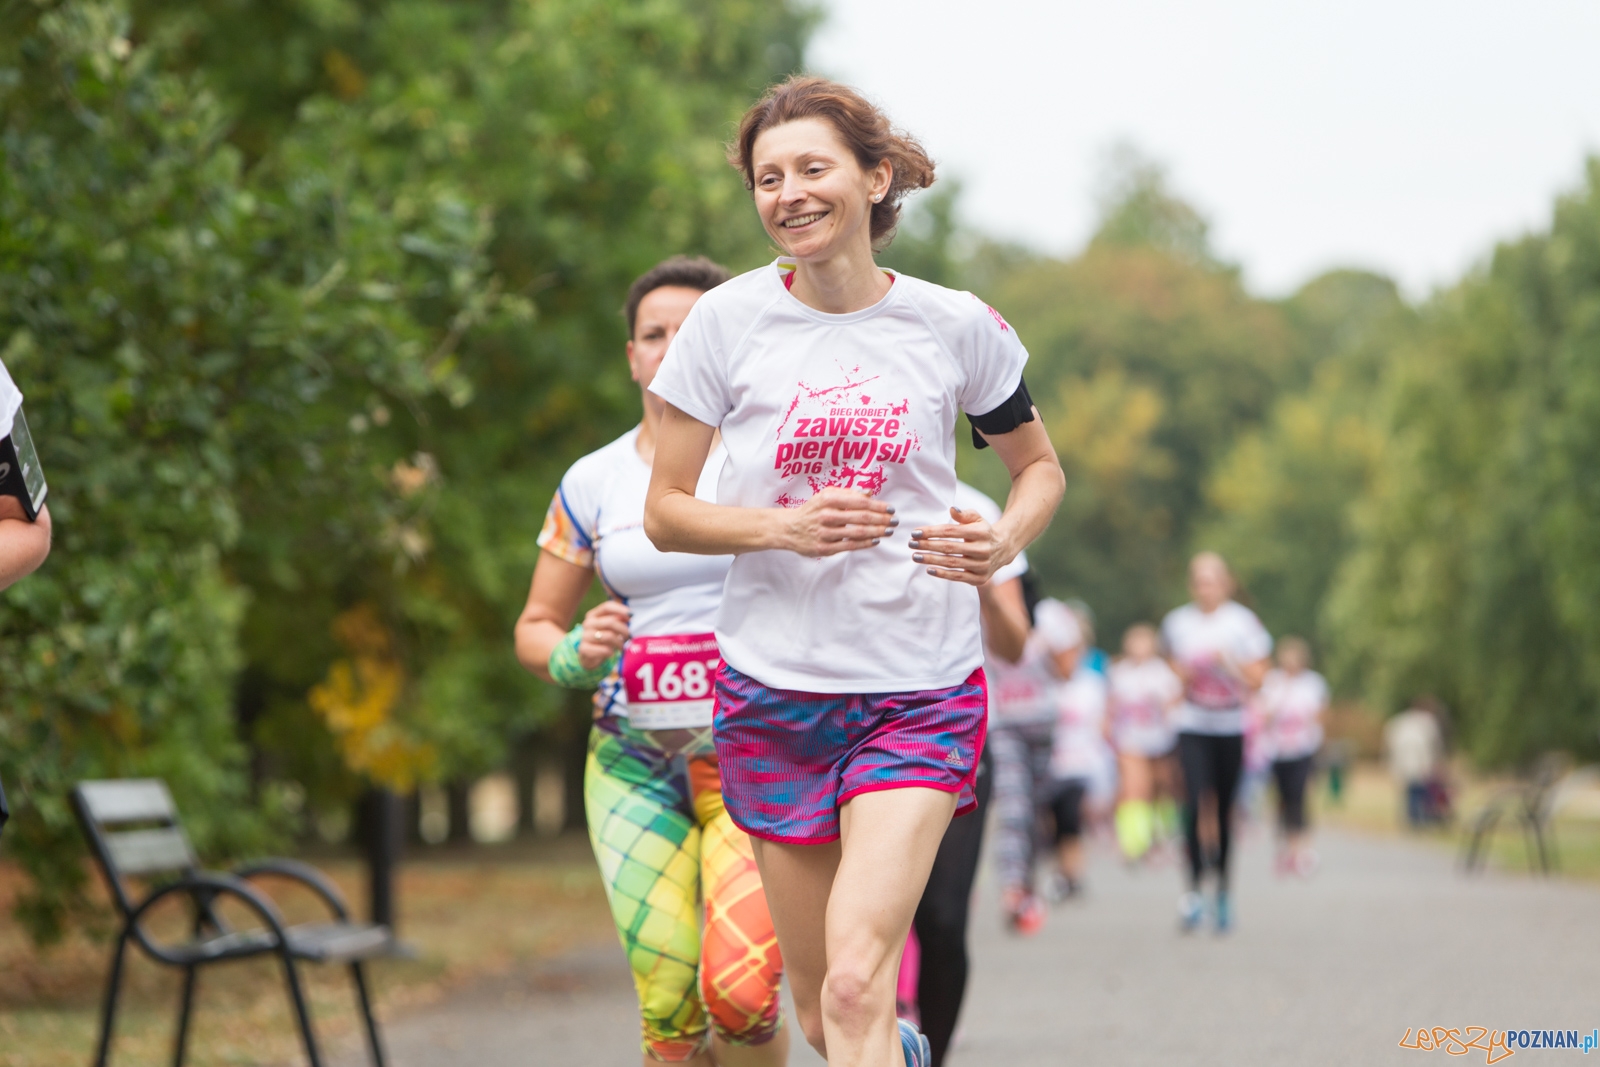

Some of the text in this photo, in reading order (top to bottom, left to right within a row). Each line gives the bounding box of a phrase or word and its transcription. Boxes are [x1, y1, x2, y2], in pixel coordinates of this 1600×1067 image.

[829, 408, 889, 417] BIEG KOBIET
[793, 417, 900, 437] zawsze
[781, 461, 823, 479] 2016
